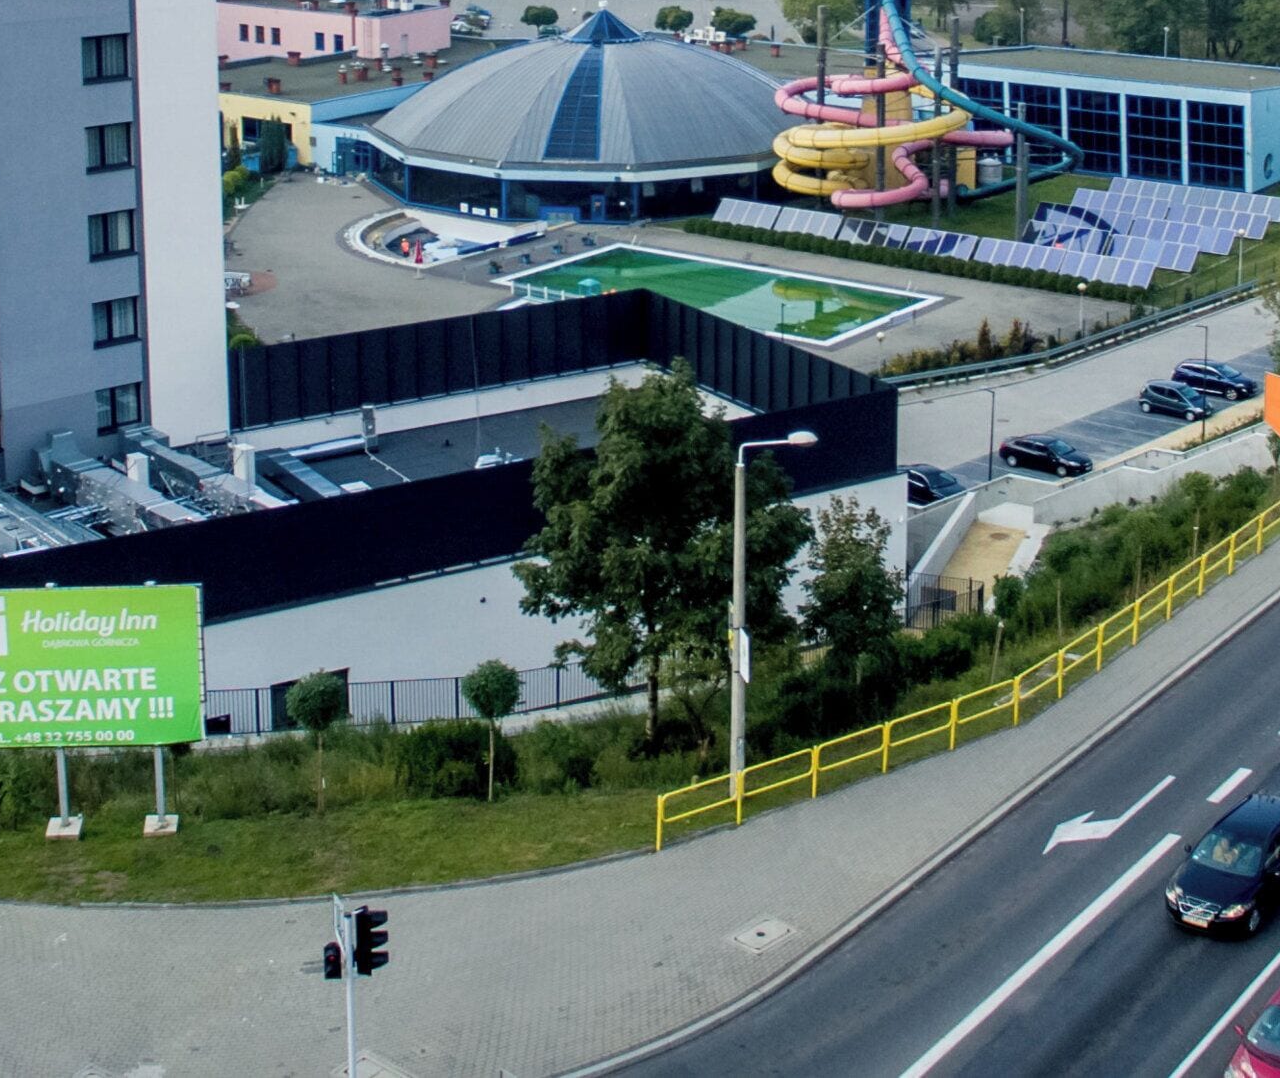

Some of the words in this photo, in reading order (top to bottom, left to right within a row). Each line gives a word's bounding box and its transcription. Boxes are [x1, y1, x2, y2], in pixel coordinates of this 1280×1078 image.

[21, 609, 117, 637] Holiday
[119, 607, 157, 631] Inn
[13, 667, 157, 693] OTWARTE
[149, 697, 175, 718] !!!
[15, 732, 41, 743] +48
[45, 732, 63, 742] 32
[65, 731, 93, 742] 755
[95, 730, 114, 741] 00
[116, 729, 135, 741] 00
